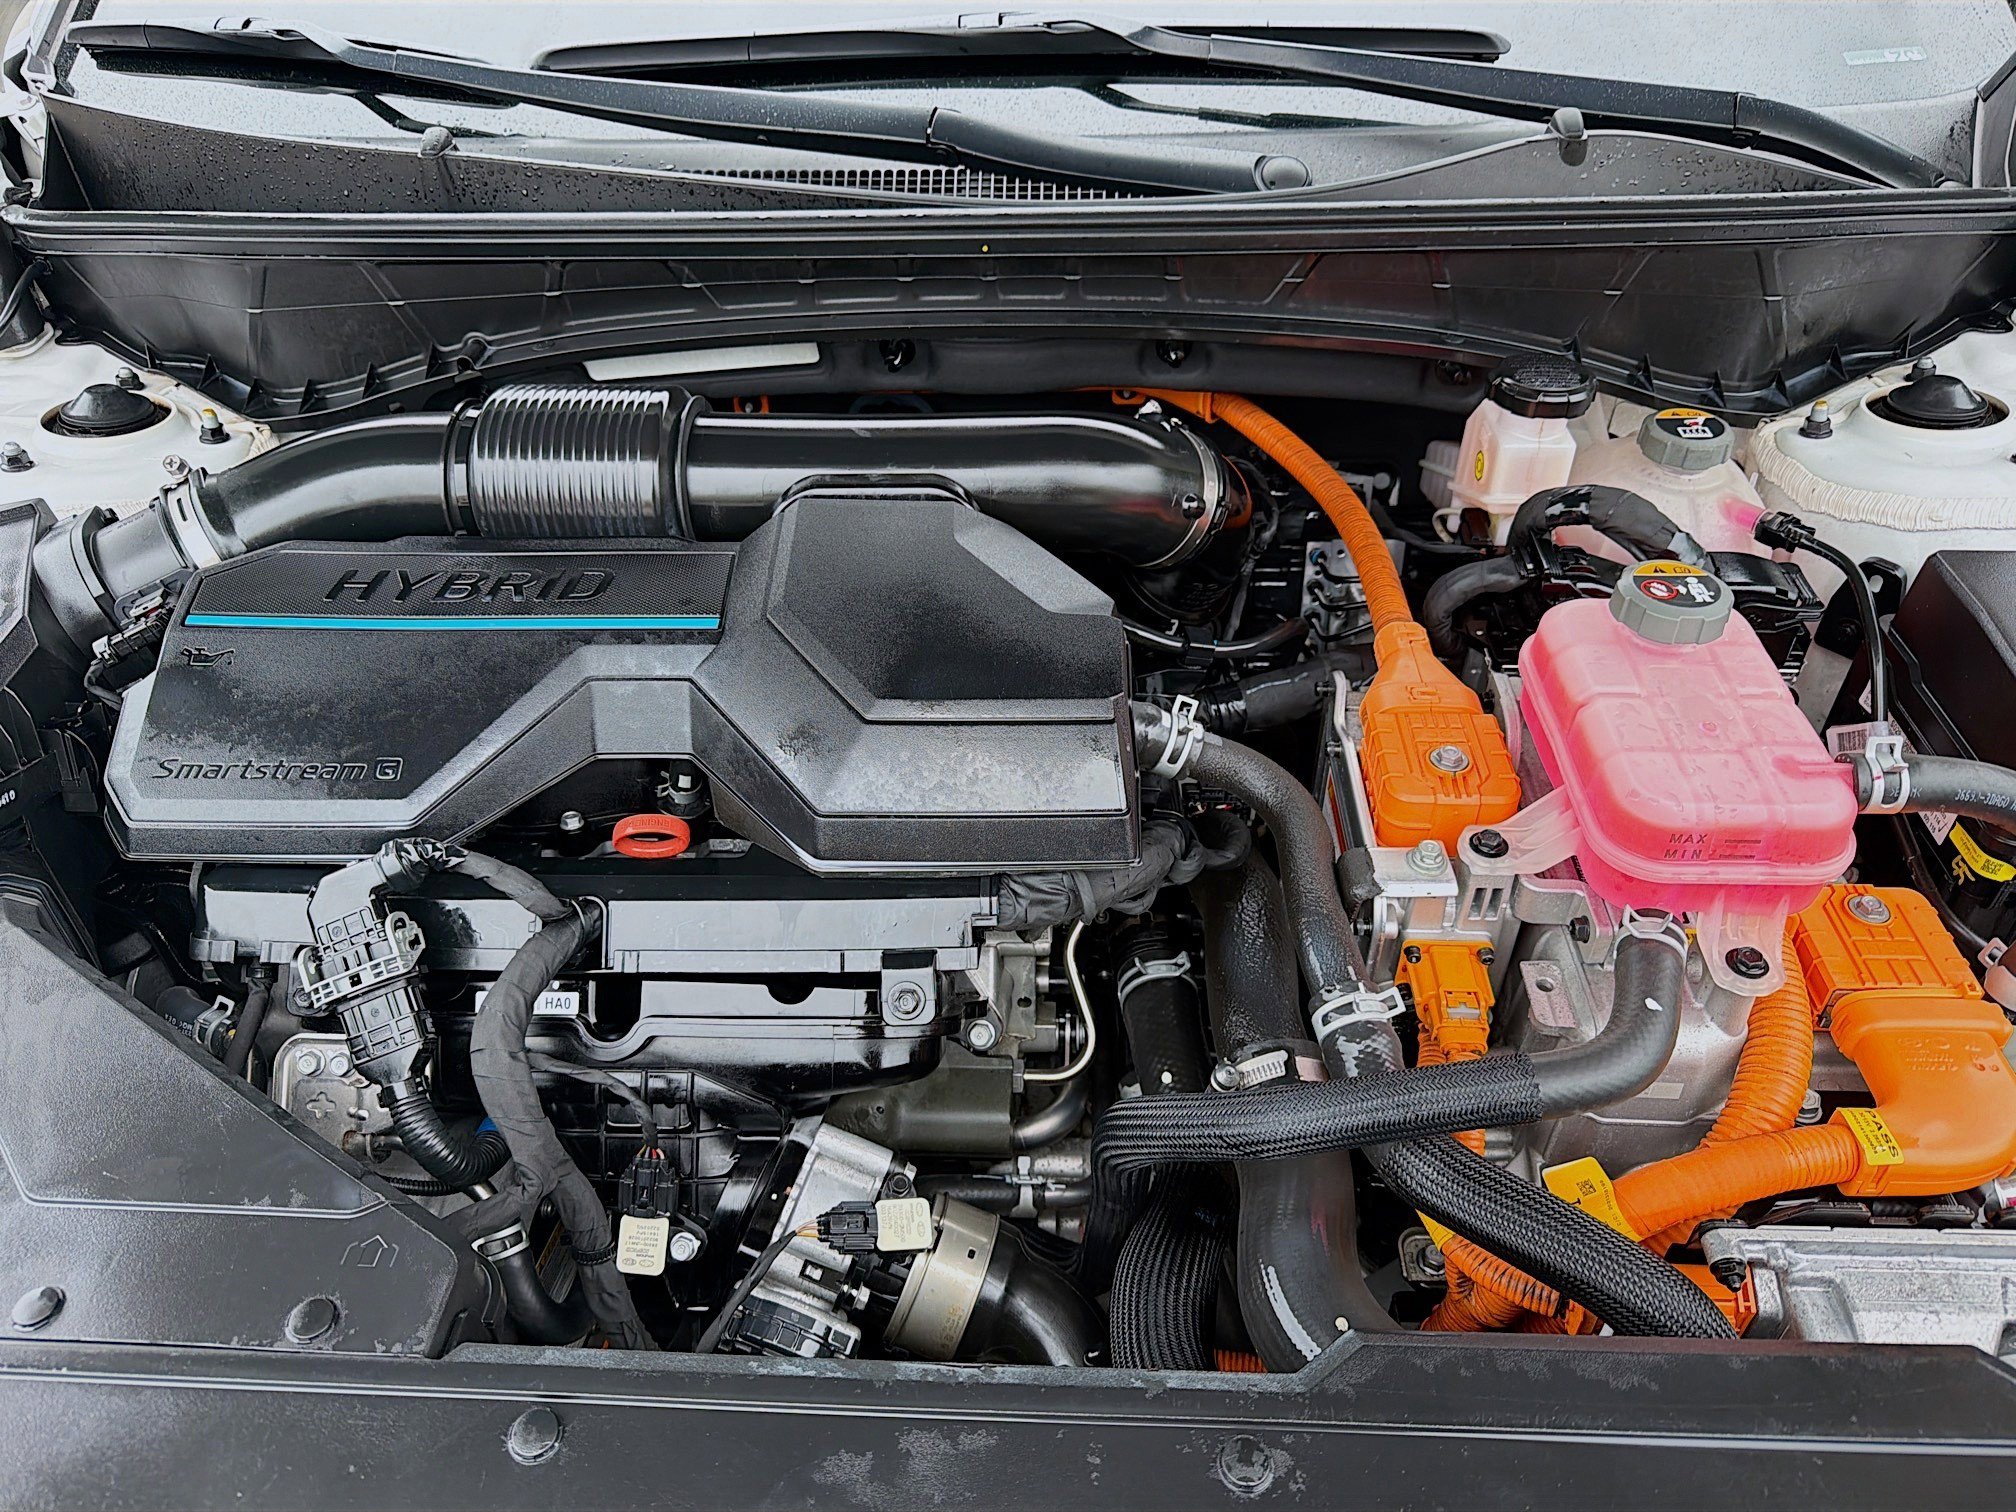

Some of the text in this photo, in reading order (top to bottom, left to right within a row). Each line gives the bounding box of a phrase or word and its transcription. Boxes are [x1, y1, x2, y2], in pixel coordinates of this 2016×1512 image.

[323, 569, 616, 602] HYBRID
[152, 757, 402, 781] Smartstream G
[634, 818, 670, 828] ENGINE
[1669, 833, 1708, 844] MAX
[1664, 849, 1702, 859] MIN
[1864, 1110, 1899, 1158] PASS
